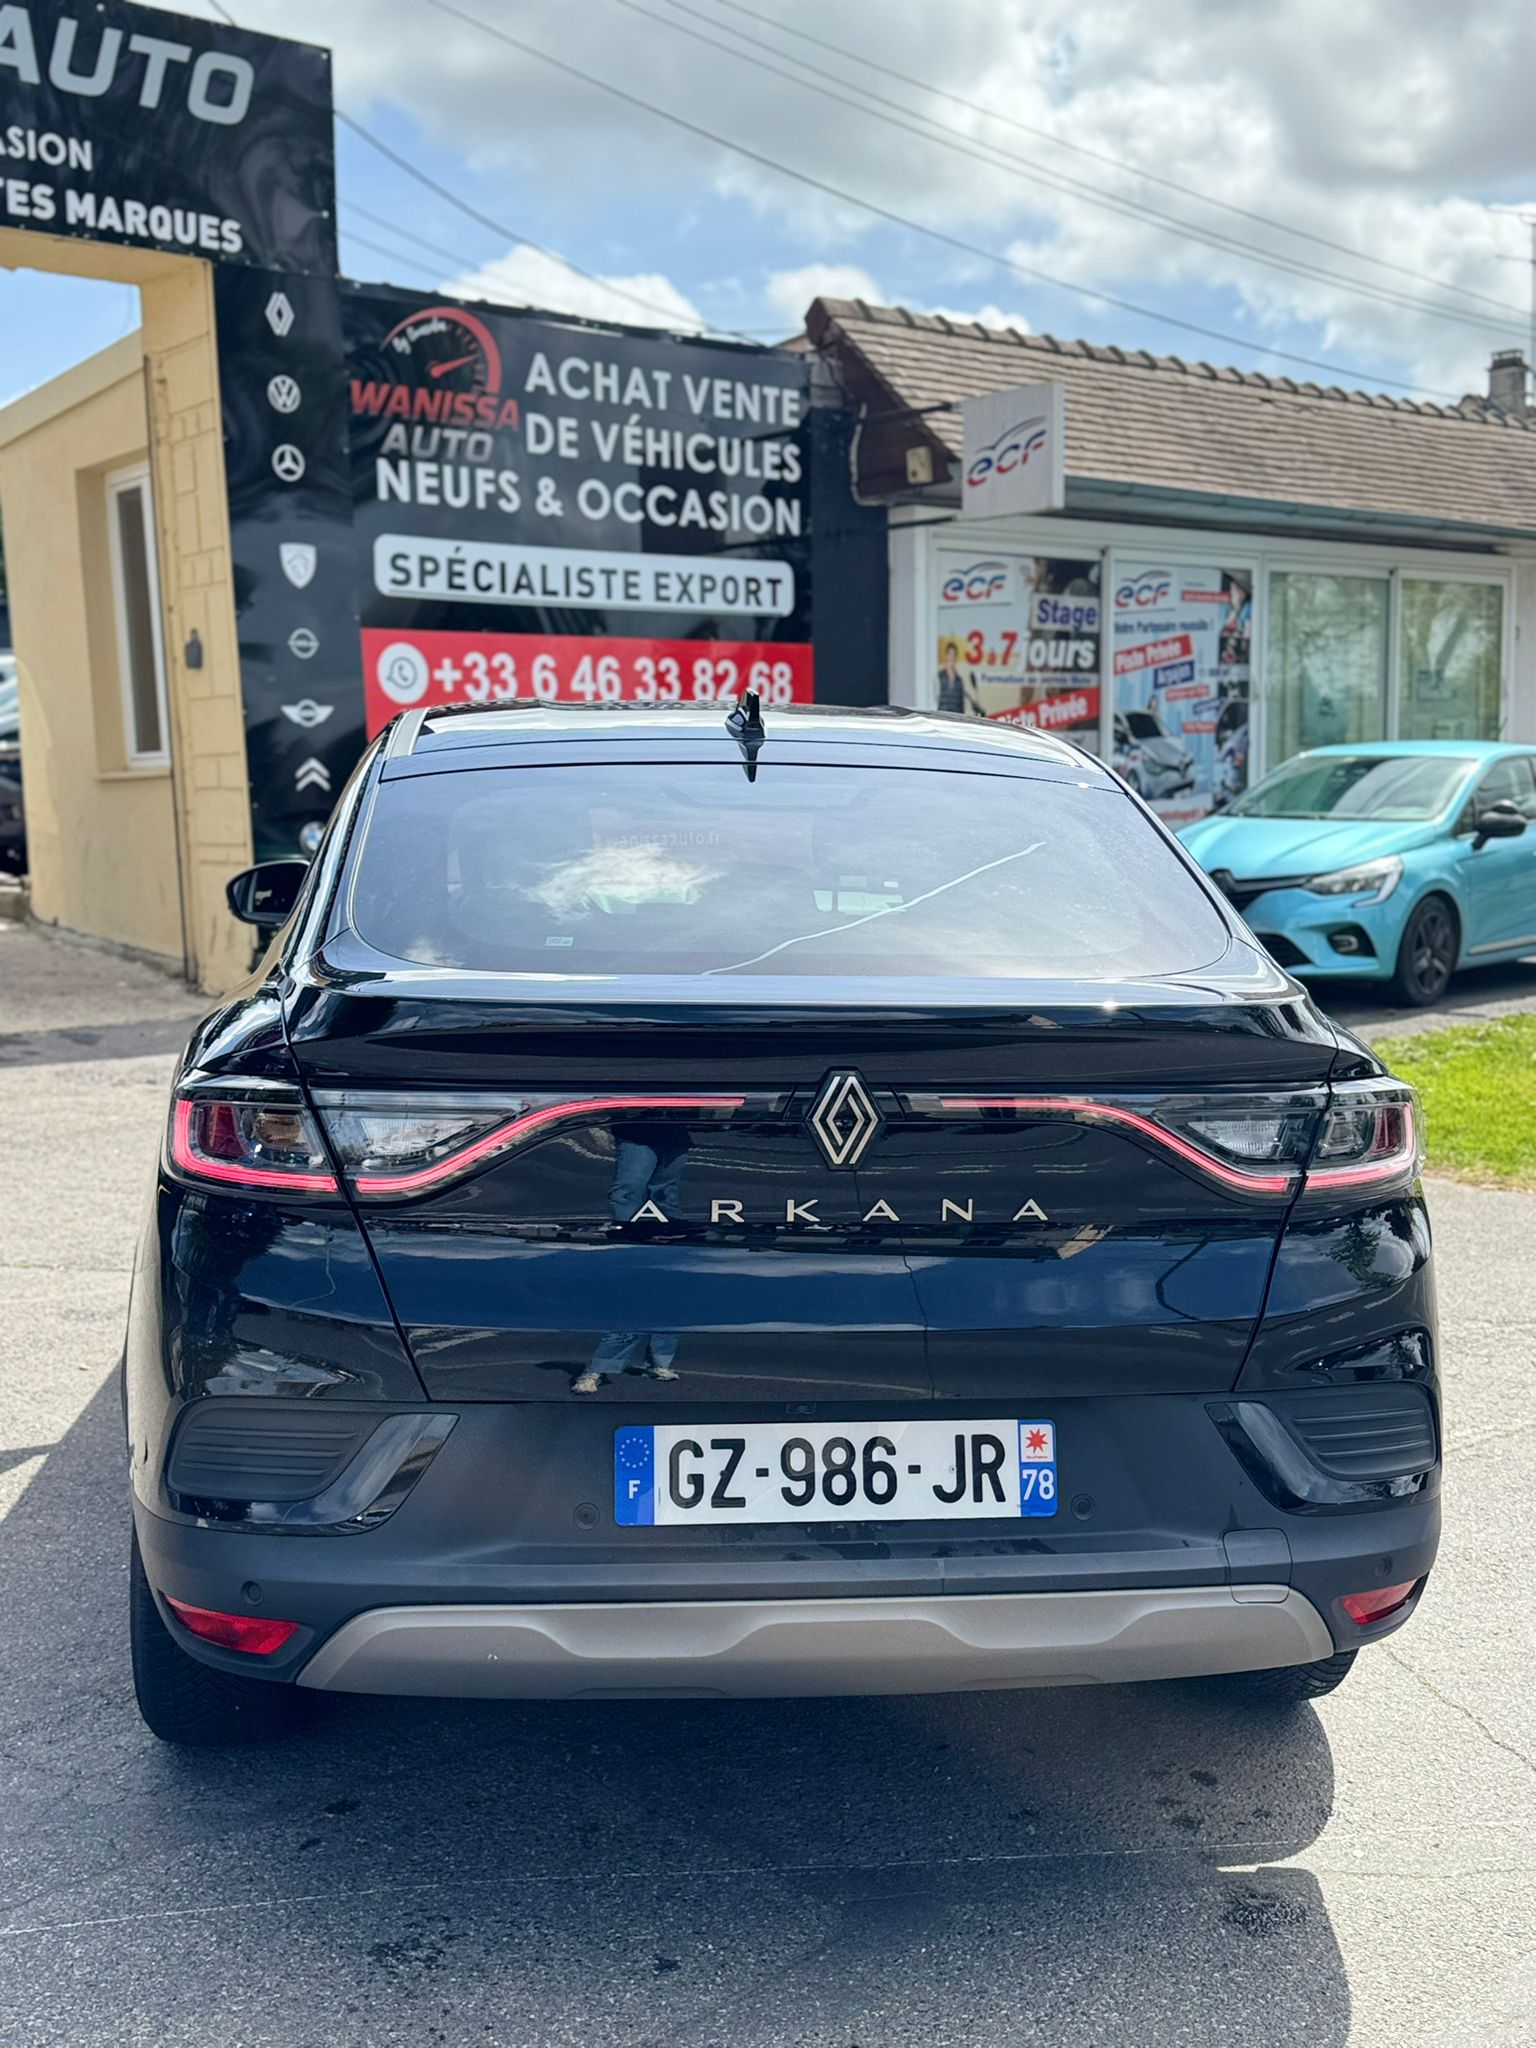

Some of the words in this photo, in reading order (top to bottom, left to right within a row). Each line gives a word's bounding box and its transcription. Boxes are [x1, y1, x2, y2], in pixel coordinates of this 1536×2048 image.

[0, 4, 254, 125] AUTO
[0, 125, 93, 171] SION
[0, 177, 56, 220] ES
[65, 189, 243, 253] MARQUES
[350, 380, 520, 431] WANISSA
[524, 353, 671, 411] ACHAT
[683, 375, 801, 427] VENTE
[380, 423, 493, 464] AUTO
[526, 412, 579, 459] DE
[590, 414, 802, 483] VÉHICULES
[376, 458, 520, 513] NEUFS
[535, 476, 564, 517] &
[577, 478, 801, 537] OCCASION
[389, 547, 642, 601] SPÉCIALISTE
[655, 571, 783, 608] EXPORT
[1037, 599, 1097, 630] Stage
[965, 630, 985, 667] 3
[1001, 631, 1018, 665] 7
[433, 651, 518, 700] +33
[531, 653, 558, 700] 6
[570, 655, 622, 701] 46
[633, 657, 681, 702] 33
[692, 659, 738, 702] 82
[750, 661, 793, 703] 68
[1038, 694, 1088, 728] Privée
[630, 1198, 1049, 1223] ARKANA
[628, 1480, 641, 1499] F
[668, 1433, 1007, 1509] GZ-986-JR
[1022, 1468, 1055, 1501] 78
